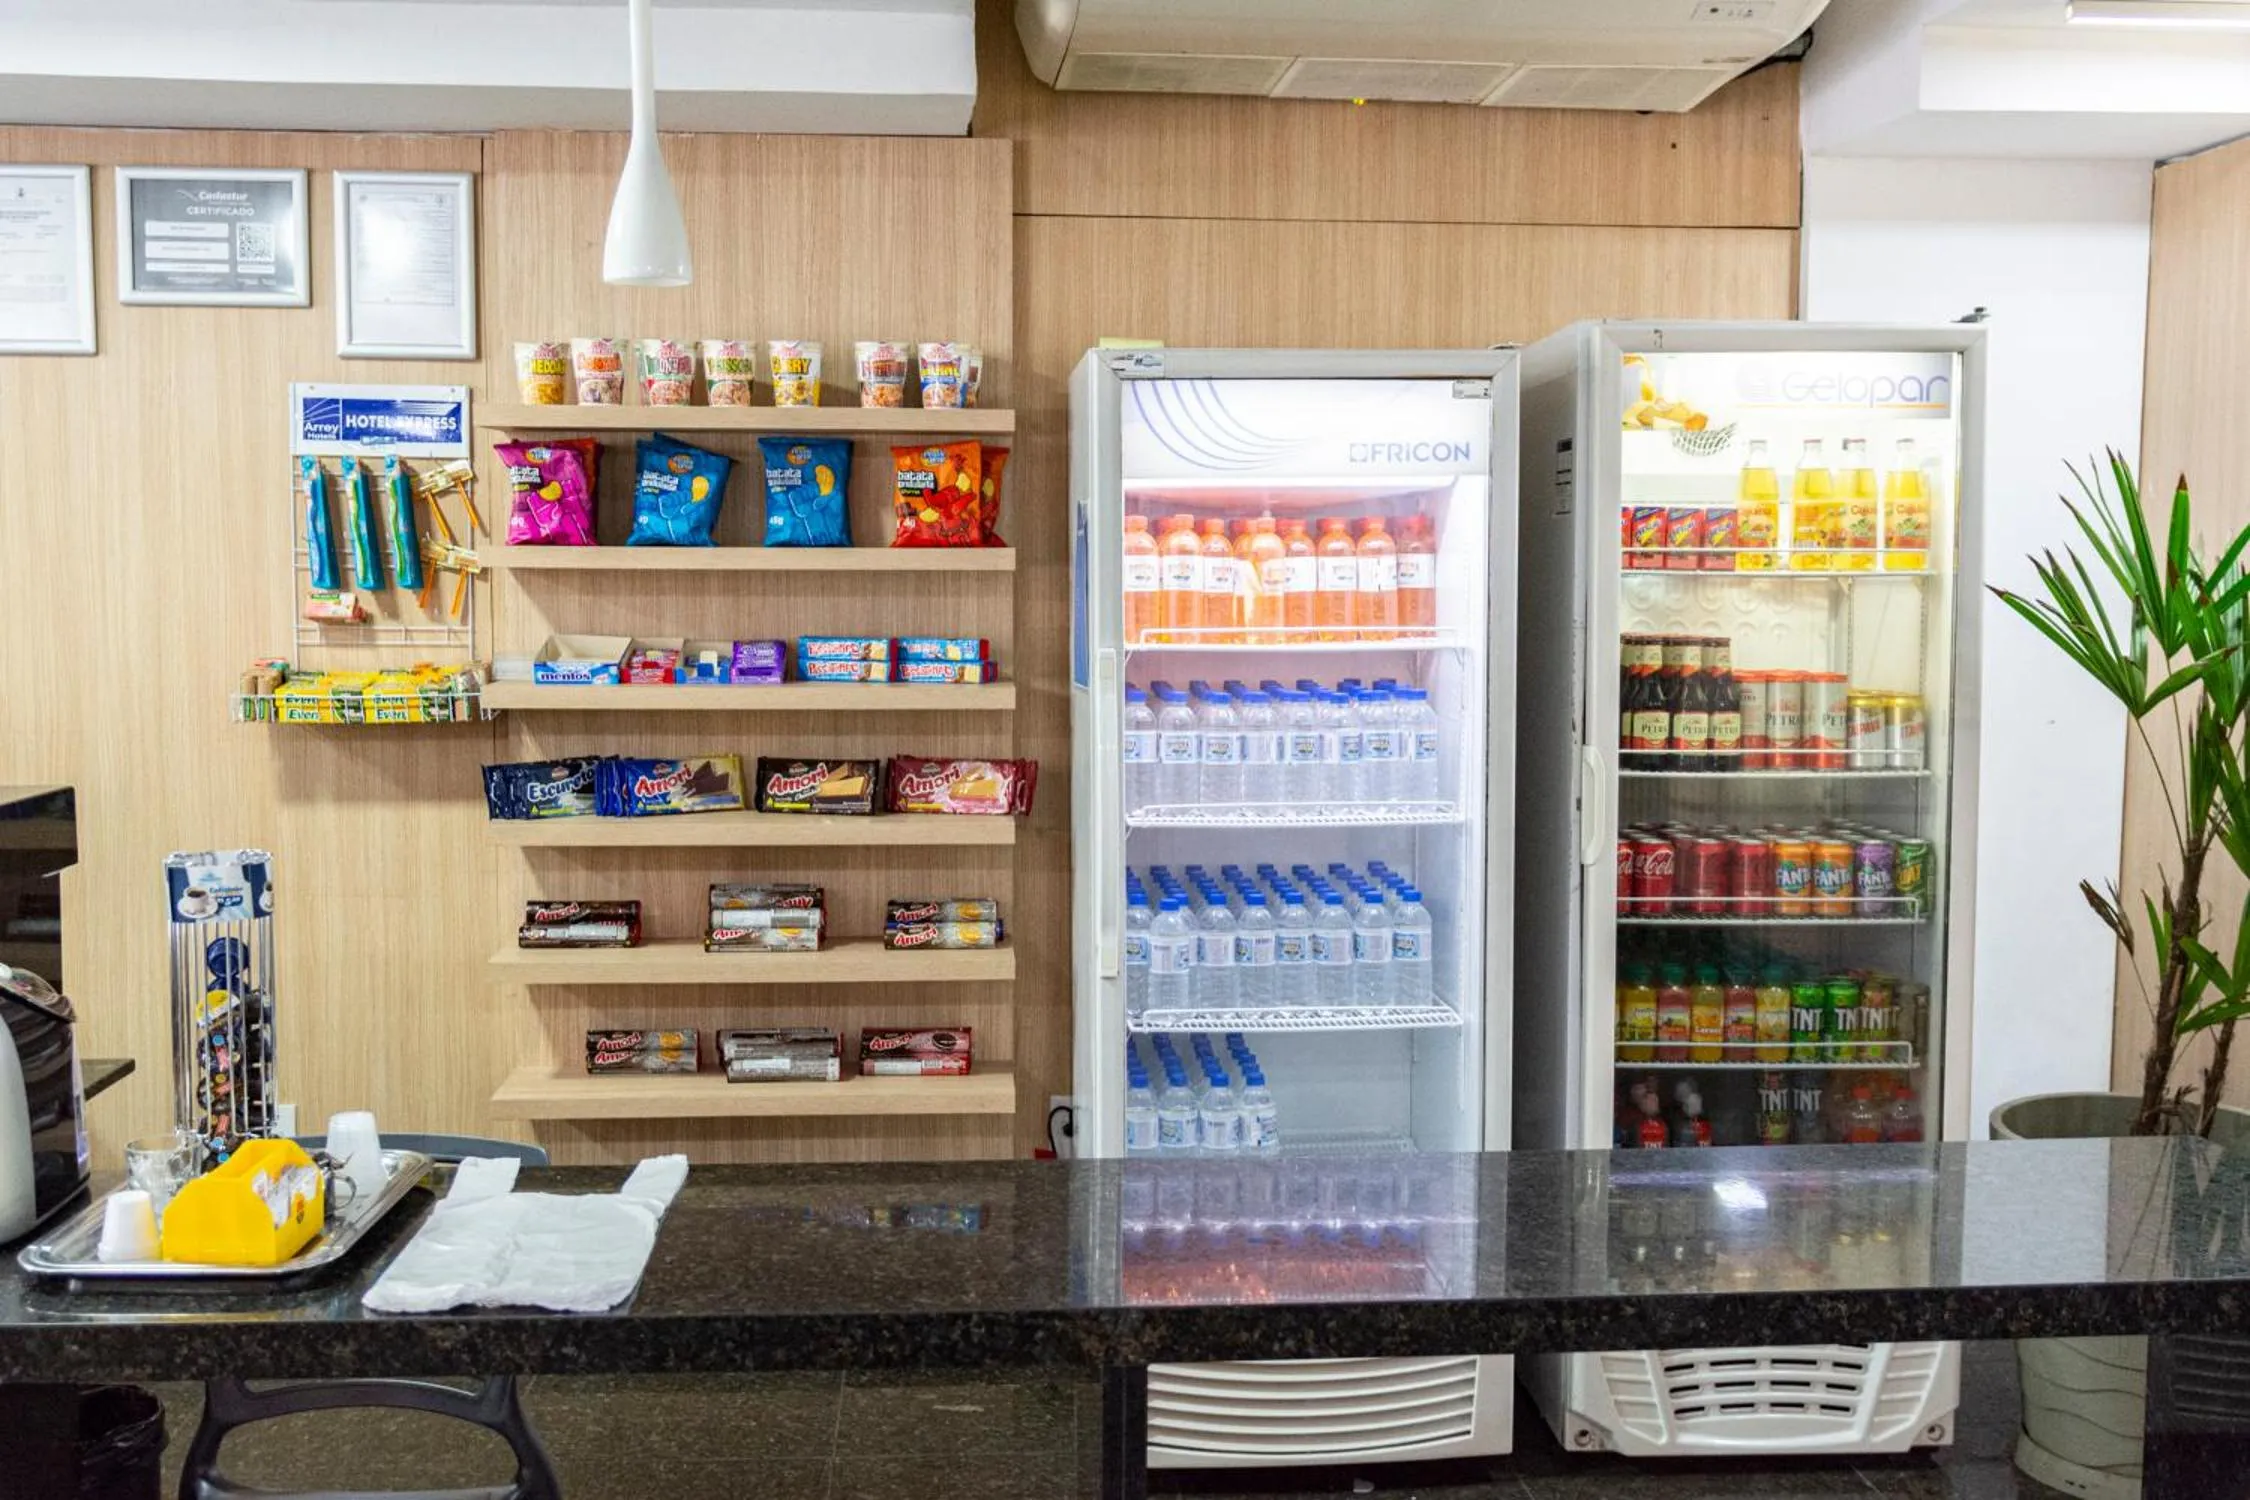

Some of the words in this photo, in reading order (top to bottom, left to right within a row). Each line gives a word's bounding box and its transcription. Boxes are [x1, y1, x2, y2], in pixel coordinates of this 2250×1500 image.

[186, 205, 255, 217] CERTIFICADO
[1781, 370, 1949, 408] Gelopar
[304, 422, 339, 433] Arrey
[346, 414, 391, 429] HOTEL
[540, 671, 591, 681] mentos
[634, 764, 695, 798] Amori
[767, 761, 829, 796] Amori
[899, 765, 962, 797] Amori
[1791, 1007, 1824, 1032] TNT
[1833, 1008, 1858, 1032] TN
[596, 1031, 642, 1051] Amori
[1759, 1088, 1790, 1112] TNT
[1792, 1089, 1823, 1112] TNT
